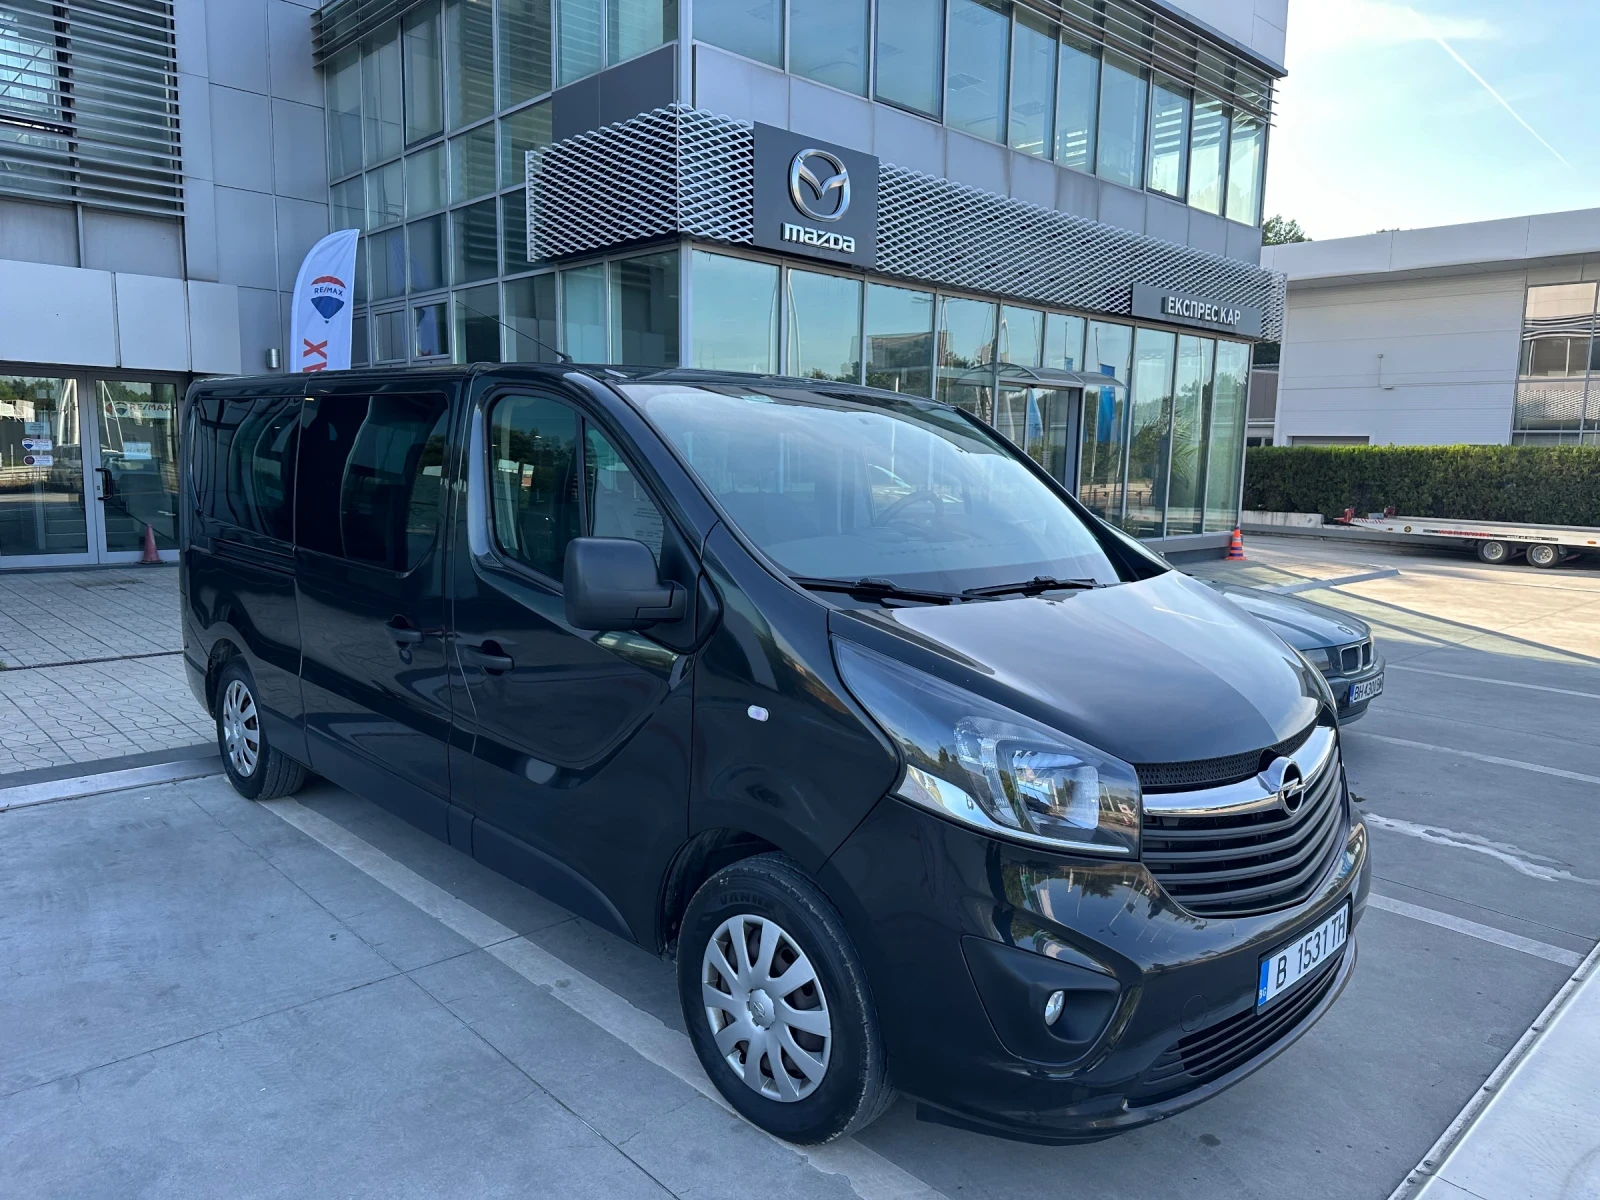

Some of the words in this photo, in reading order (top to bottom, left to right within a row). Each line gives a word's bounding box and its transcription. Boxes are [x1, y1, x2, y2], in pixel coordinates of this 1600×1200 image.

[314, 286, 343, 297] RE/MAX
[1167, 296, 1218, 321] ЕКСПРЕС
[1220, 306, 1241, 325] КАР
[129, 402, 171, 412] RE/MAX
[1276, 955, 1287, 990] B
[1297, 925, 1328, 975] 1531
[1331, 908, 1347, 948] TH
[1259, 986, 1267, 999] BG
